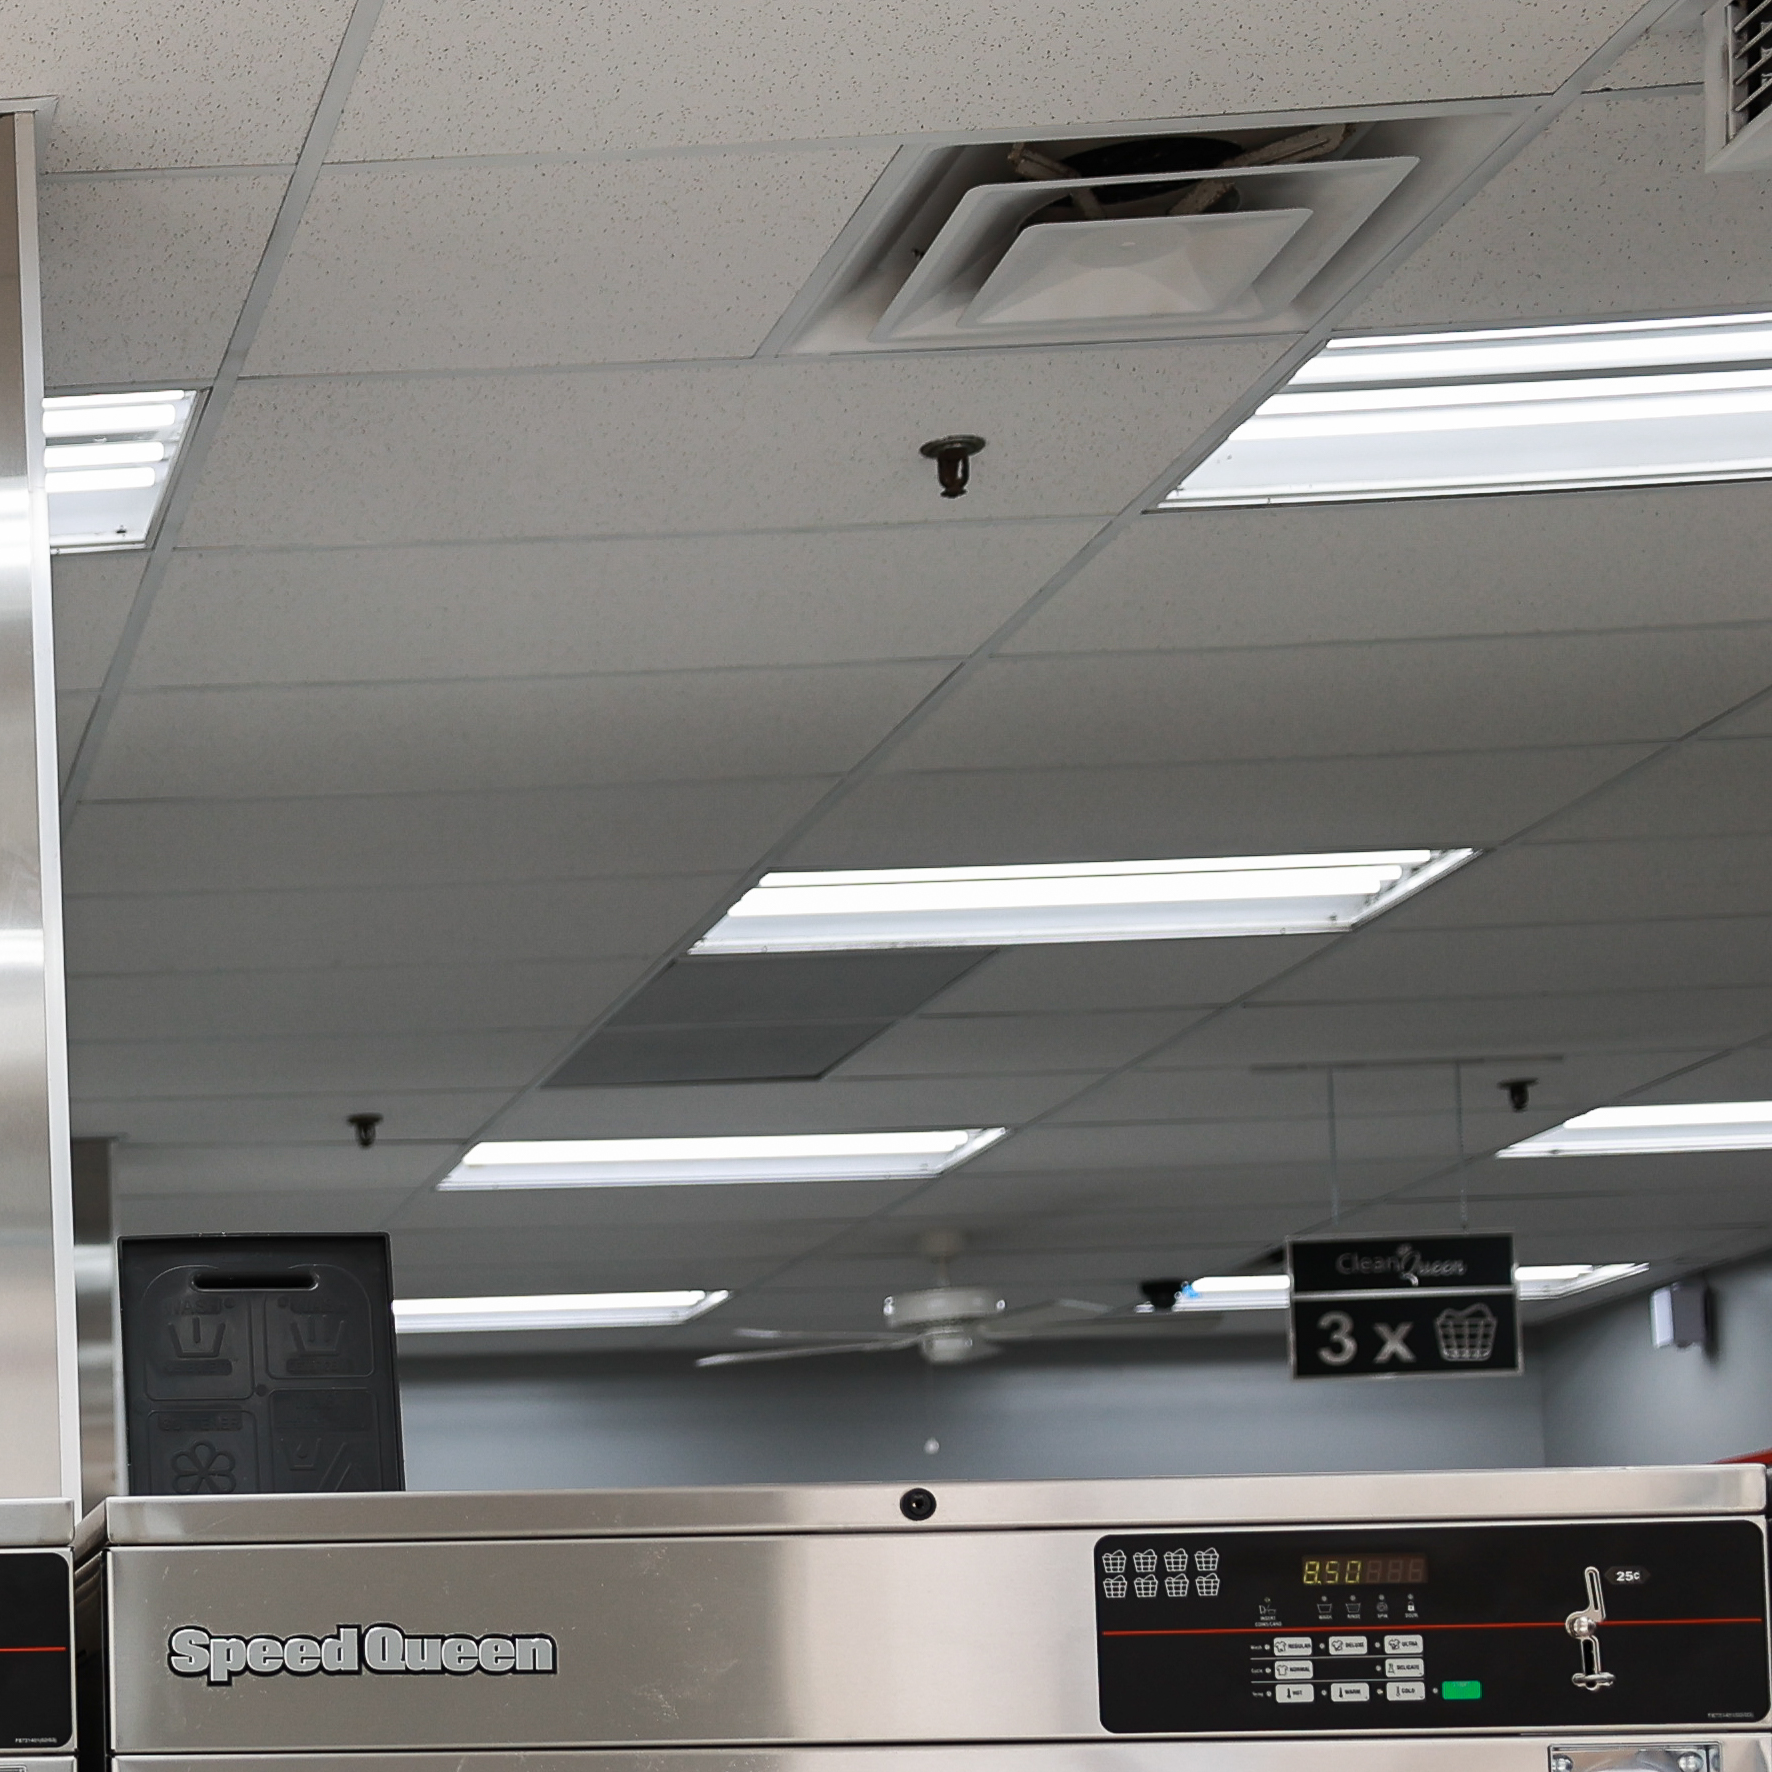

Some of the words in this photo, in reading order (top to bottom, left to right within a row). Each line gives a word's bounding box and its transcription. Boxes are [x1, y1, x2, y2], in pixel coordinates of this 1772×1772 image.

[1317, 1310, 1357, 1366] 3
[1373, 1322, 1416, 1364] x
[168, 1624, 362, 1686] Speed
[362, 1621, 557, 1674] Queen
